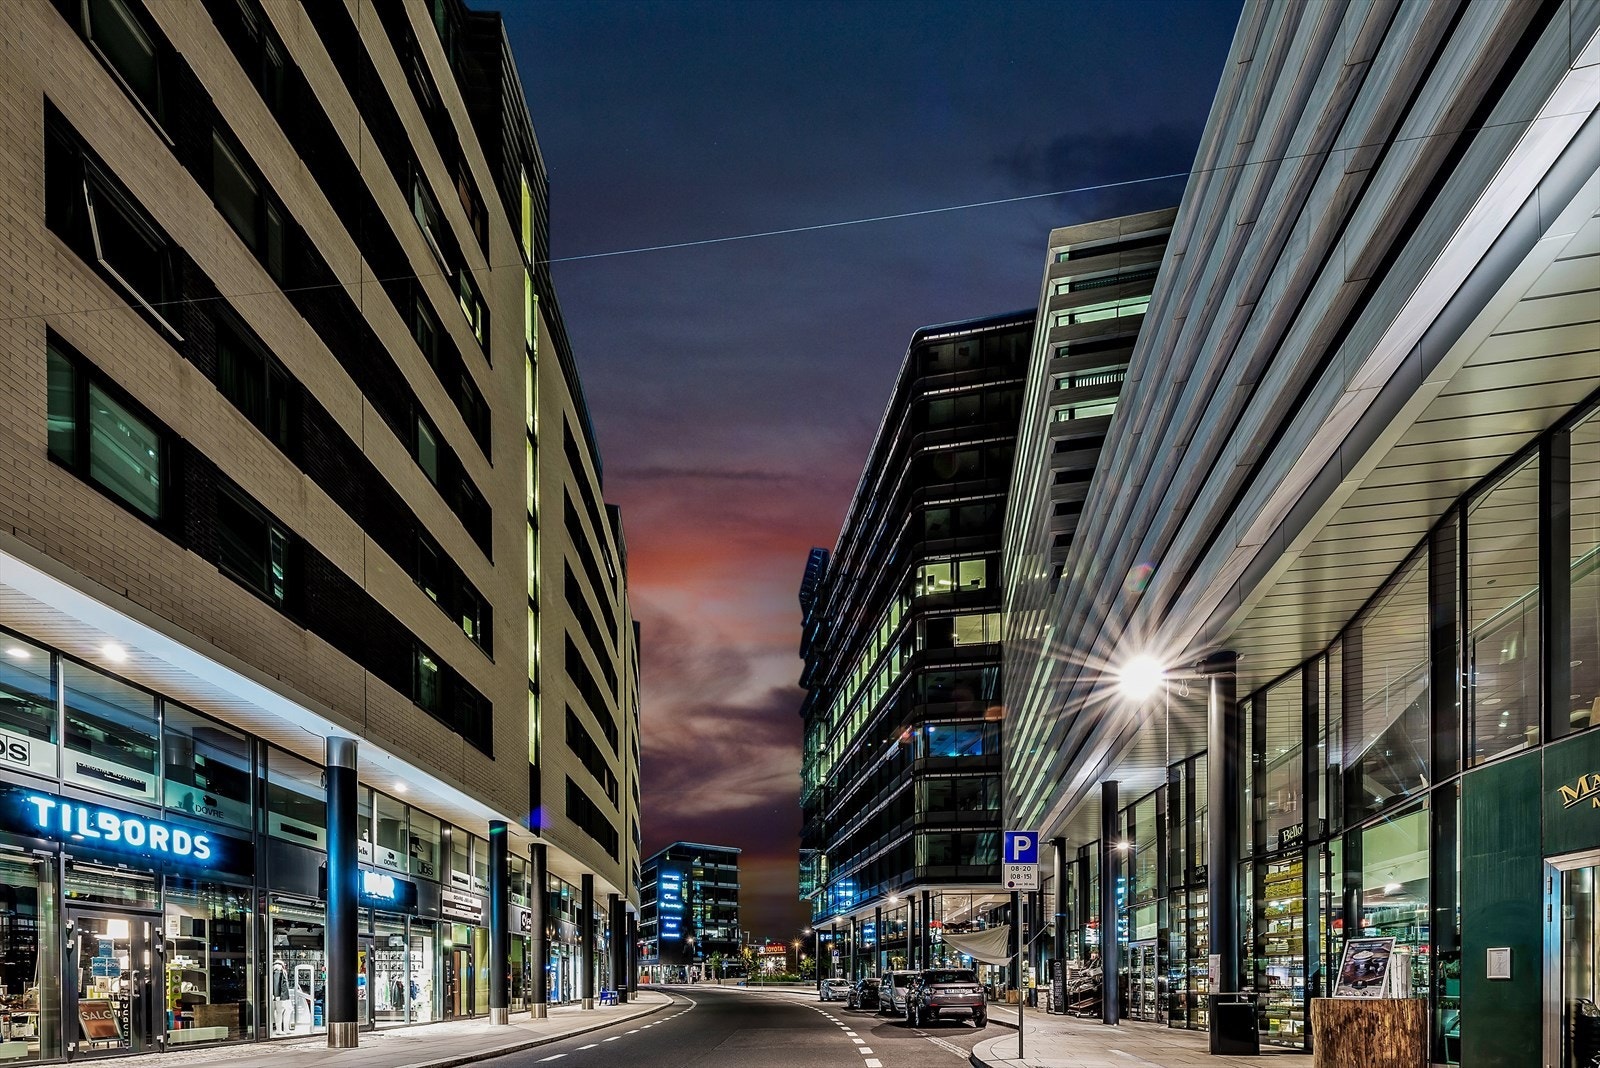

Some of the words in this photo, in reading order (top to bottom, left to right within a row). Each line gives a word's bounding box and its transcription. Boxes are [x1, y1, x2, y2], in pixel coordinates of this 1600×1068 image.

[195, 804, 225, 819] DOVRE
[29, 796, 211, 860] TILBORDS
[1013, 835, 1032, 861] P
[766, 945, 784, 953] TOYOTA
[81, 1010, 113, 1021] SALG
